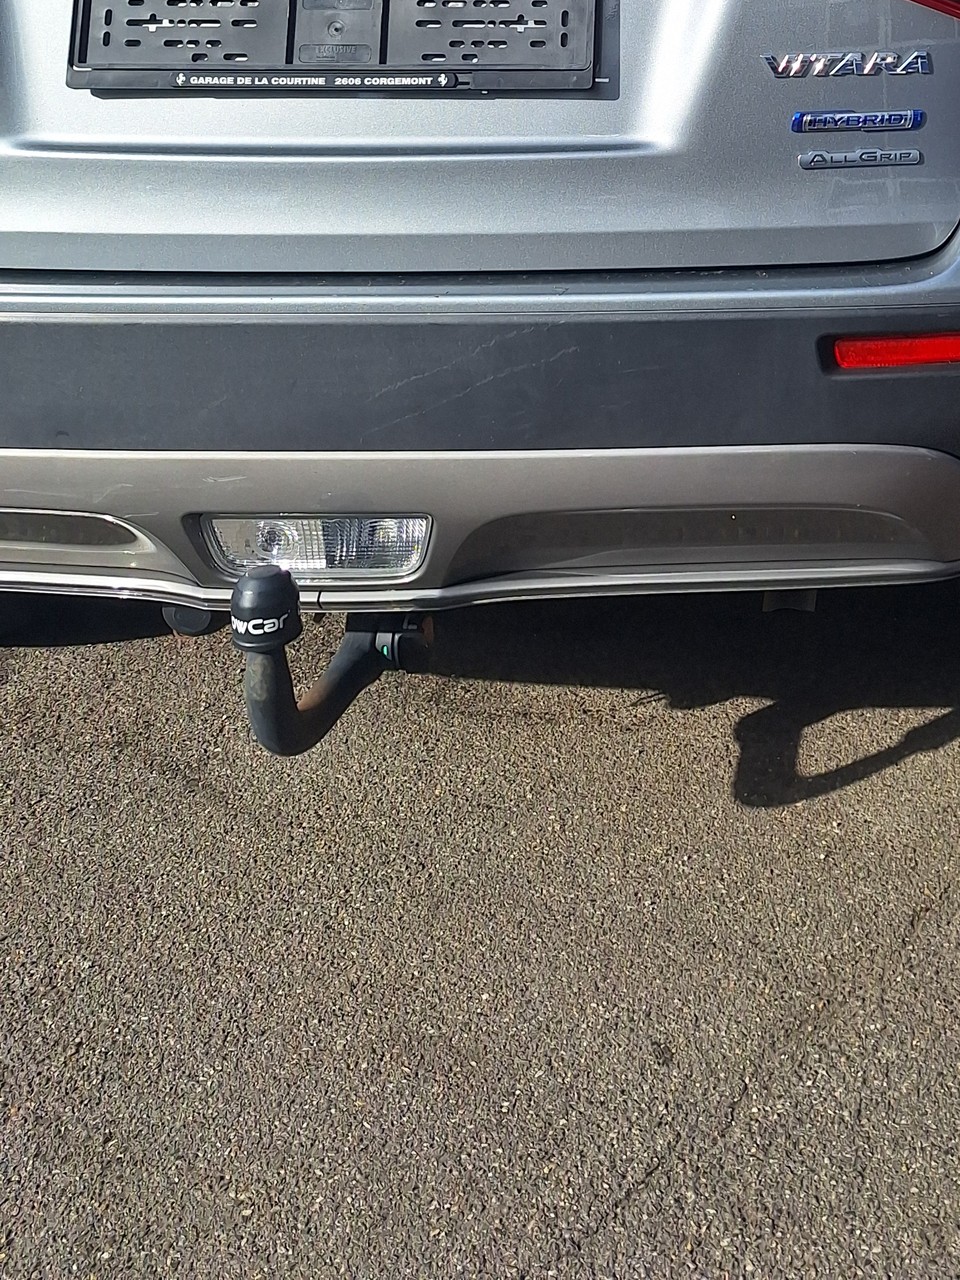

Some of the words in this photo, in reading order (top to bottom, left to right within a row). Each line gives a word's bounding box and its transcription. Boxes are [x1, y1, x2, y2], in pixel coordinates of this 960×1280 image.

[760, 51, 932, 77] VITARA
[190, 76, 235, 85] GARAGE
[236, 76, 252, 85] DE
[254, 76, 269, 85] LA
[271, 77, 326, 86] COURTINE
[334, 77, 361, 86] 2606
[364, 77, 433, 86] CORGEMONT
[811, 114, 905, 129] HYBRID
